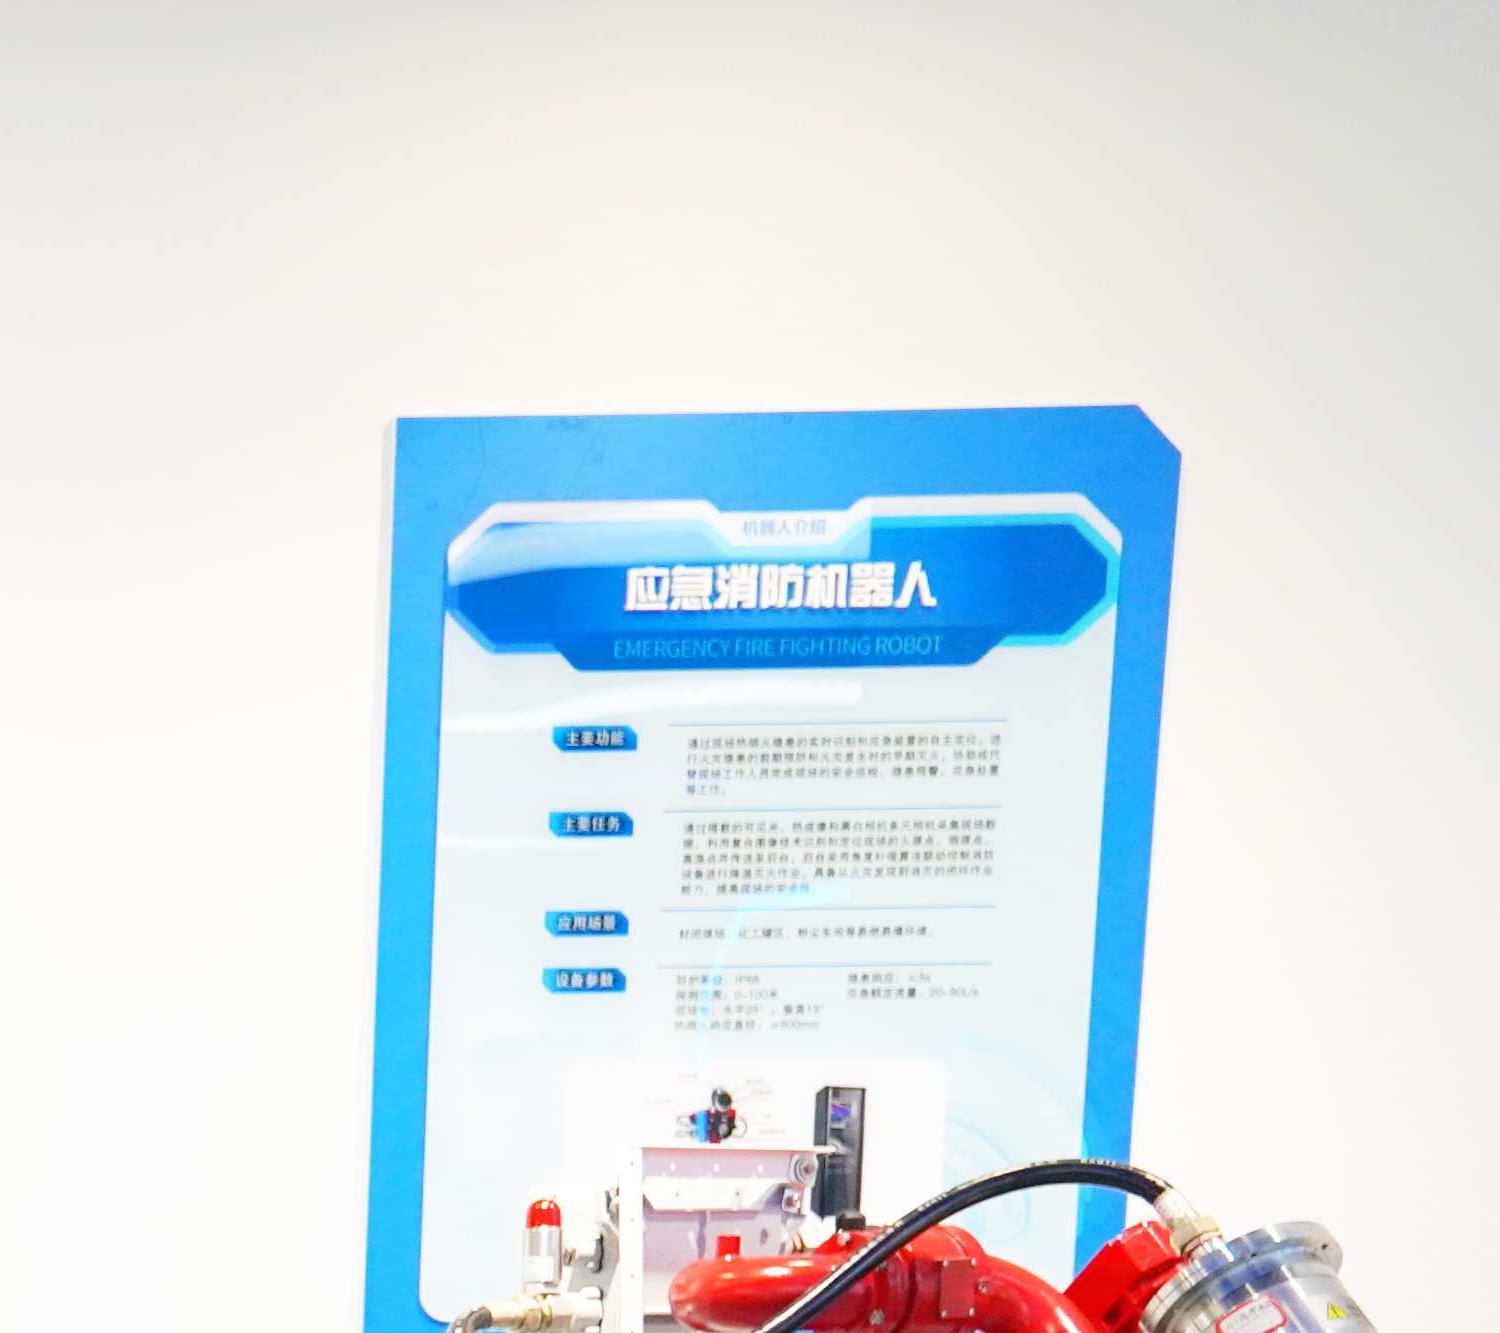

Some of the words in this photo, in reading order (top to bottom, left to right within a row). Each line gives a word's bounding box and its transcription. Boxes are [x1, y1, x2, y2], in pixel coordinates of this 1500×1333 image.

[743, 517, 827, 538] 机器人介绍
[623, 560, 938, 613] 应急消防机器人
[613, 637, 732, 660] EMERGENCY
[735, 636, 776, 657] FIRE
[780, 635, 870, 657] FIGHTING
[874, 633, 943, 656] ROBOT
[565, 728, 627, 748] 主要功能
[562, 815, 622, 834] 主要任务
[557, 914, 617, 933] 应用场景
[555, 971, 615, 991] 设备参数
